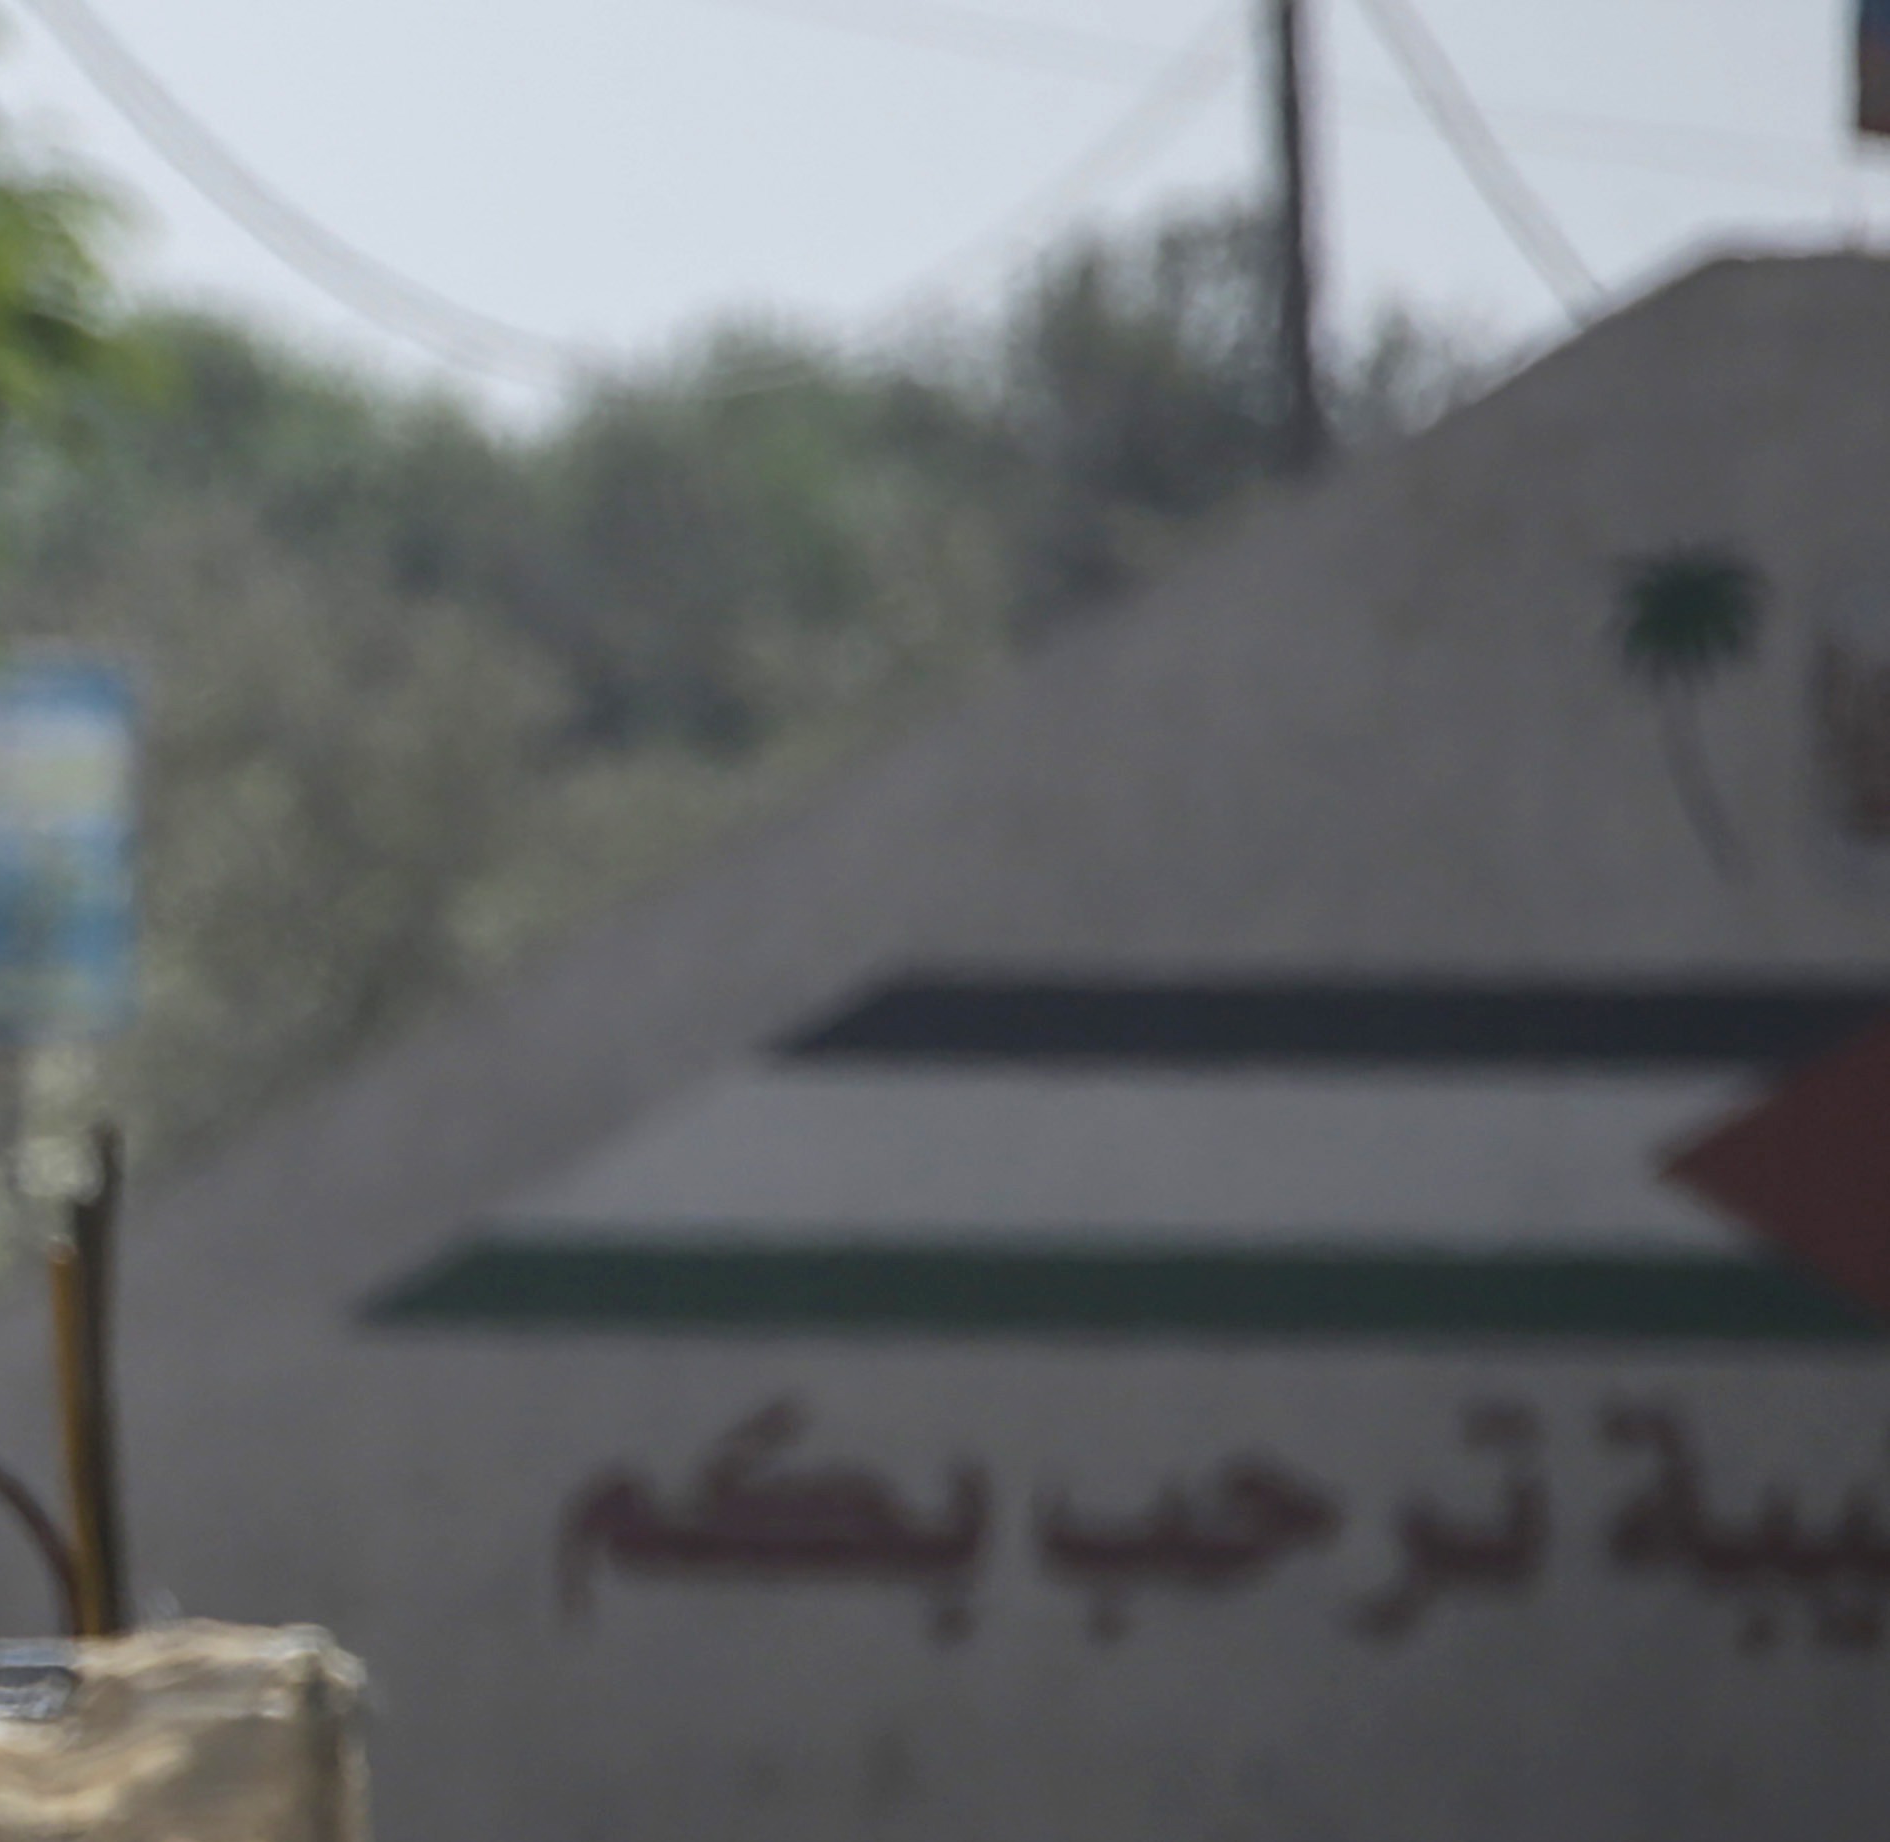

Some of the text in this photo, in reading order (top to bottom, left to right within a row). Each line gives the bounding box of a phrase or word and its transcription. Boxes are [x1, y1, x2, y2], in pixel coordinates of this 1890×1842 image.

[557, 1390, 1890, 1656] يبة ترحب بكم
